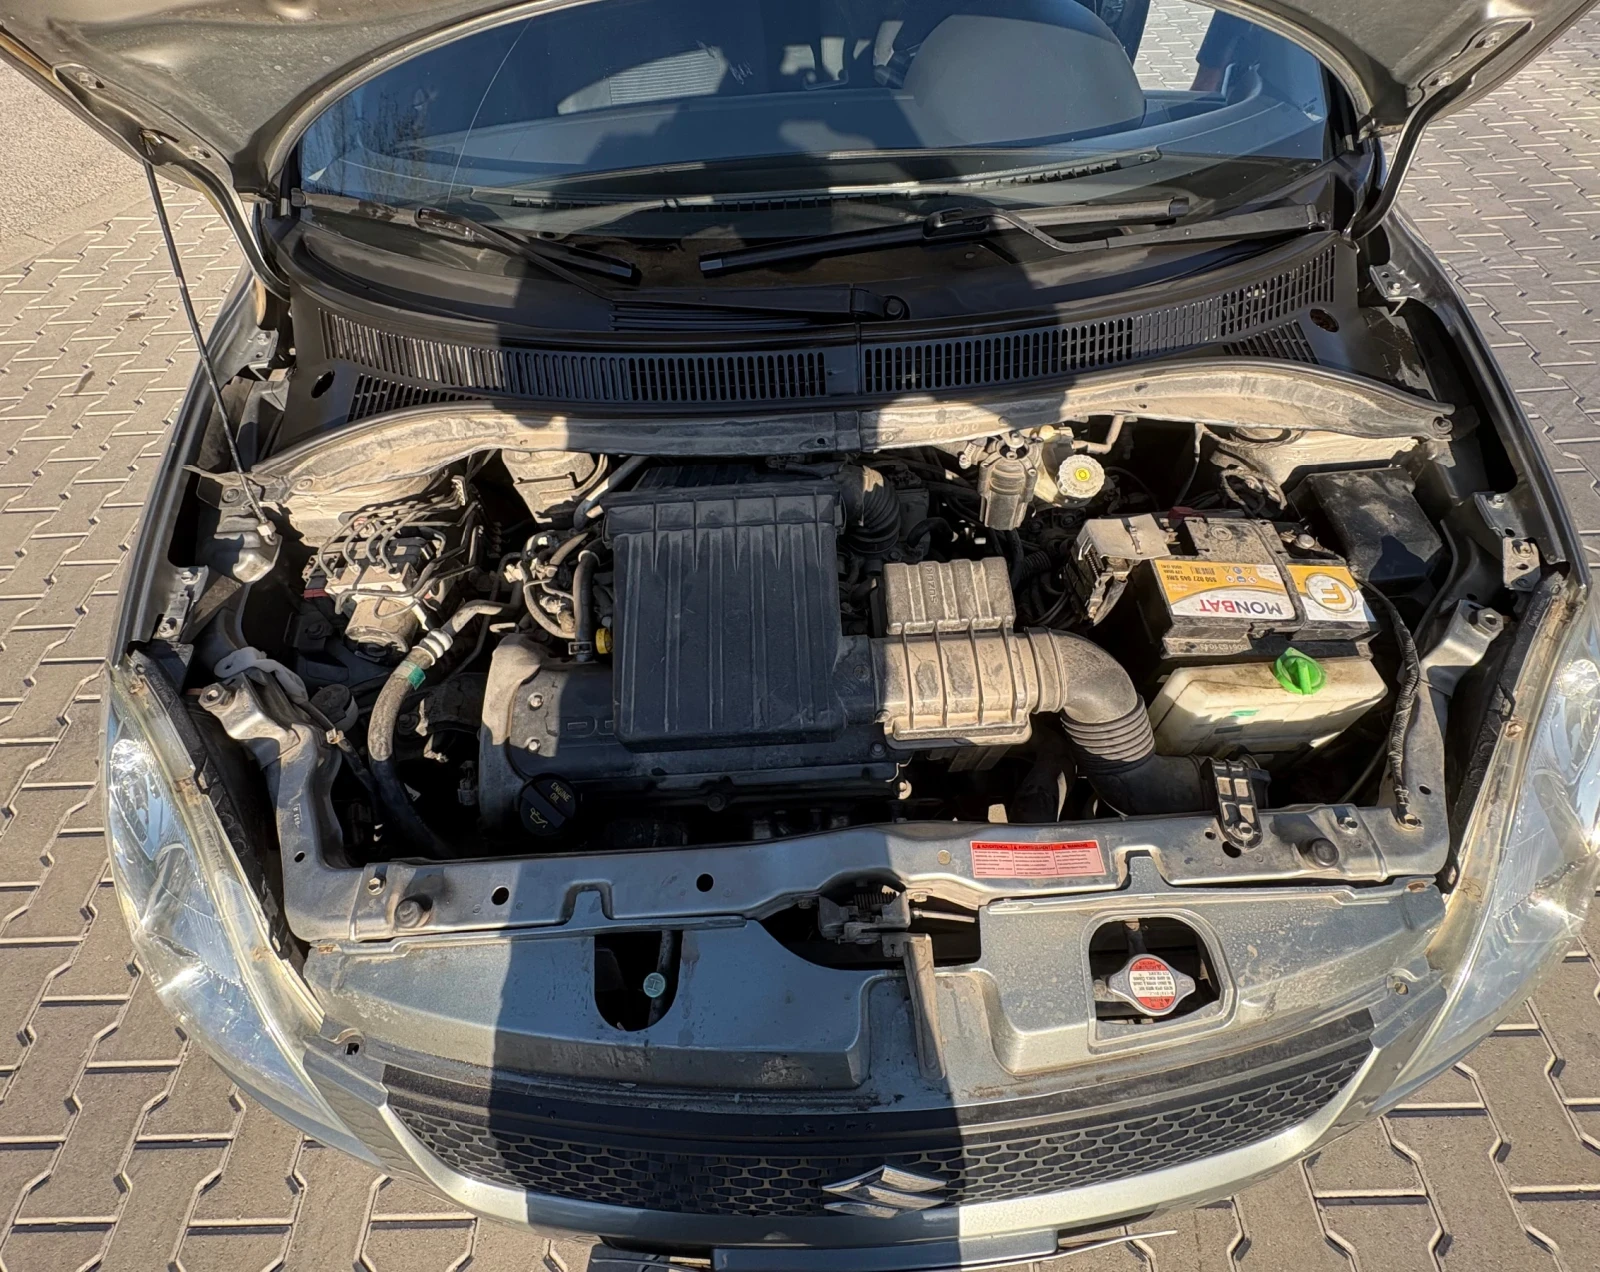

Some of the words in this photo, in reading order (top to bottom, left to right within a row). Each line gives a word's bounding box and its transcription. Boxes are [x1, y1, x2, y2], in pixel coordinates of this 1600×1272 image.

[925, 563, 939, 604] SUZUKI
[1321, 583, 1346, 603] F
[1199, 599, 1283, 615] MONBAT
[549, 792, 560, 804] OIL
[550, 781, 572, 803] ENGINE
